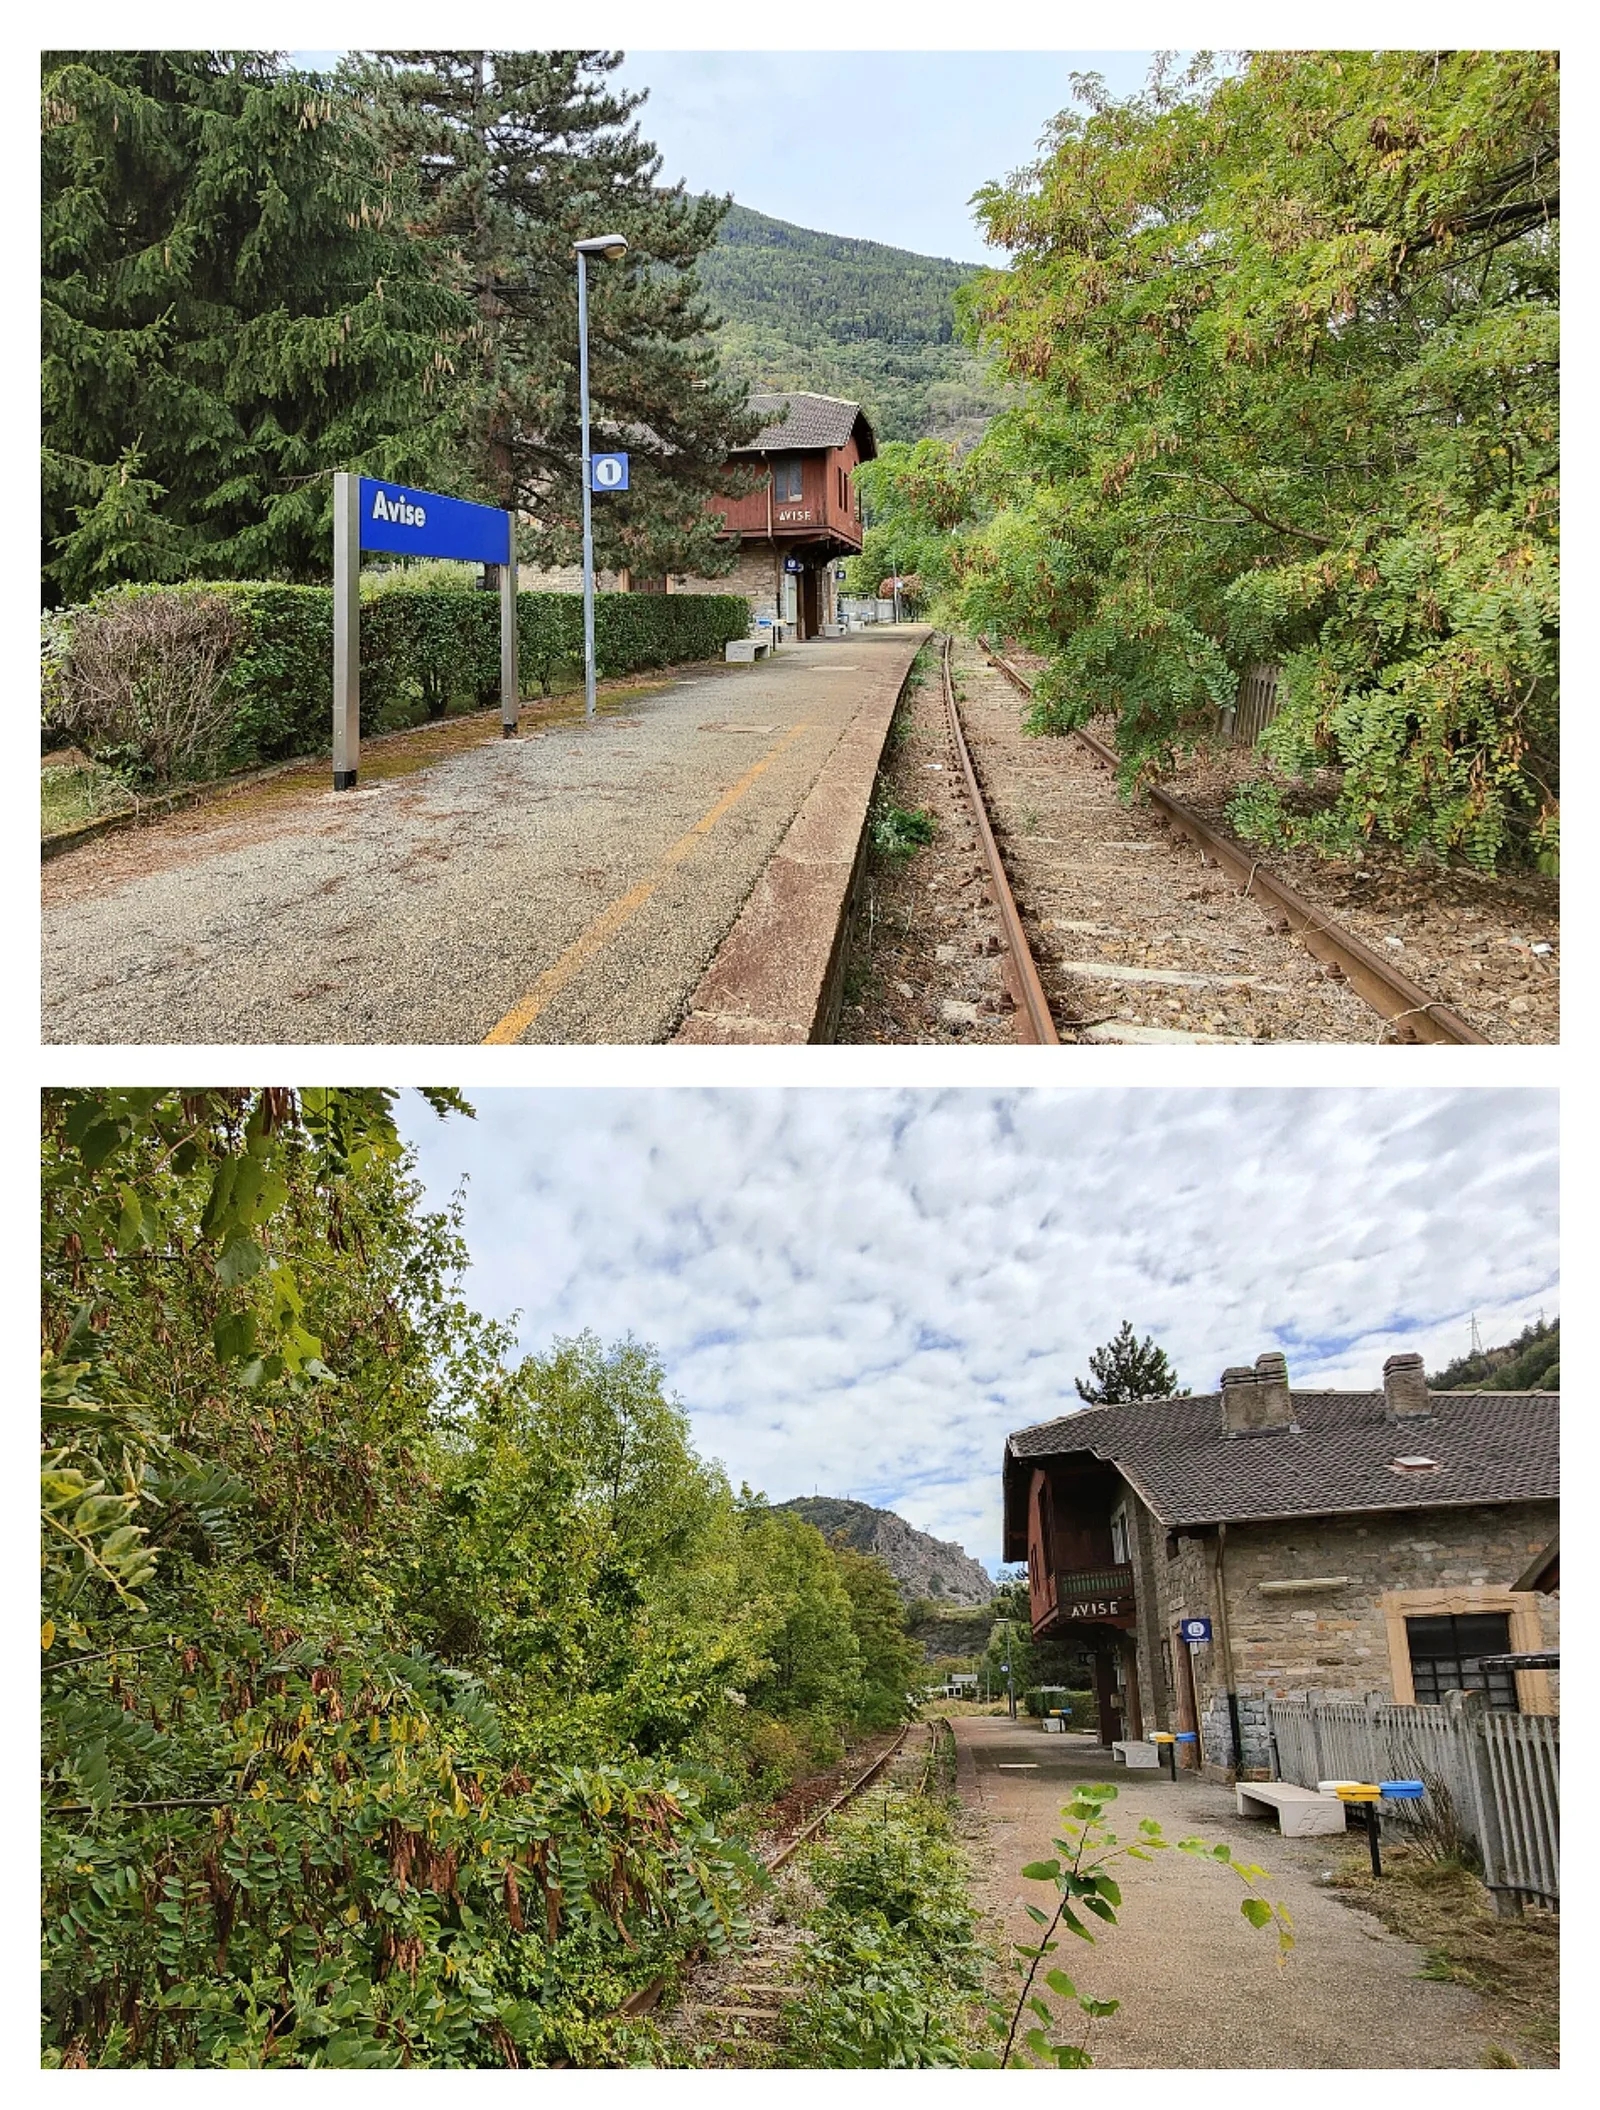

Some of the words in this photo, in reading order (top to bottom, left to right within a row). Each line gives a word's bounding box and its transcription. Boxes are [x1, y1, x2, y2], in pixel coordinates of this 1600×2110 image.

[606, 463, 613, 480] 1
[372, 490, 426, 527] Avise
[1071, 1601, 1118, 1618] AVISE
